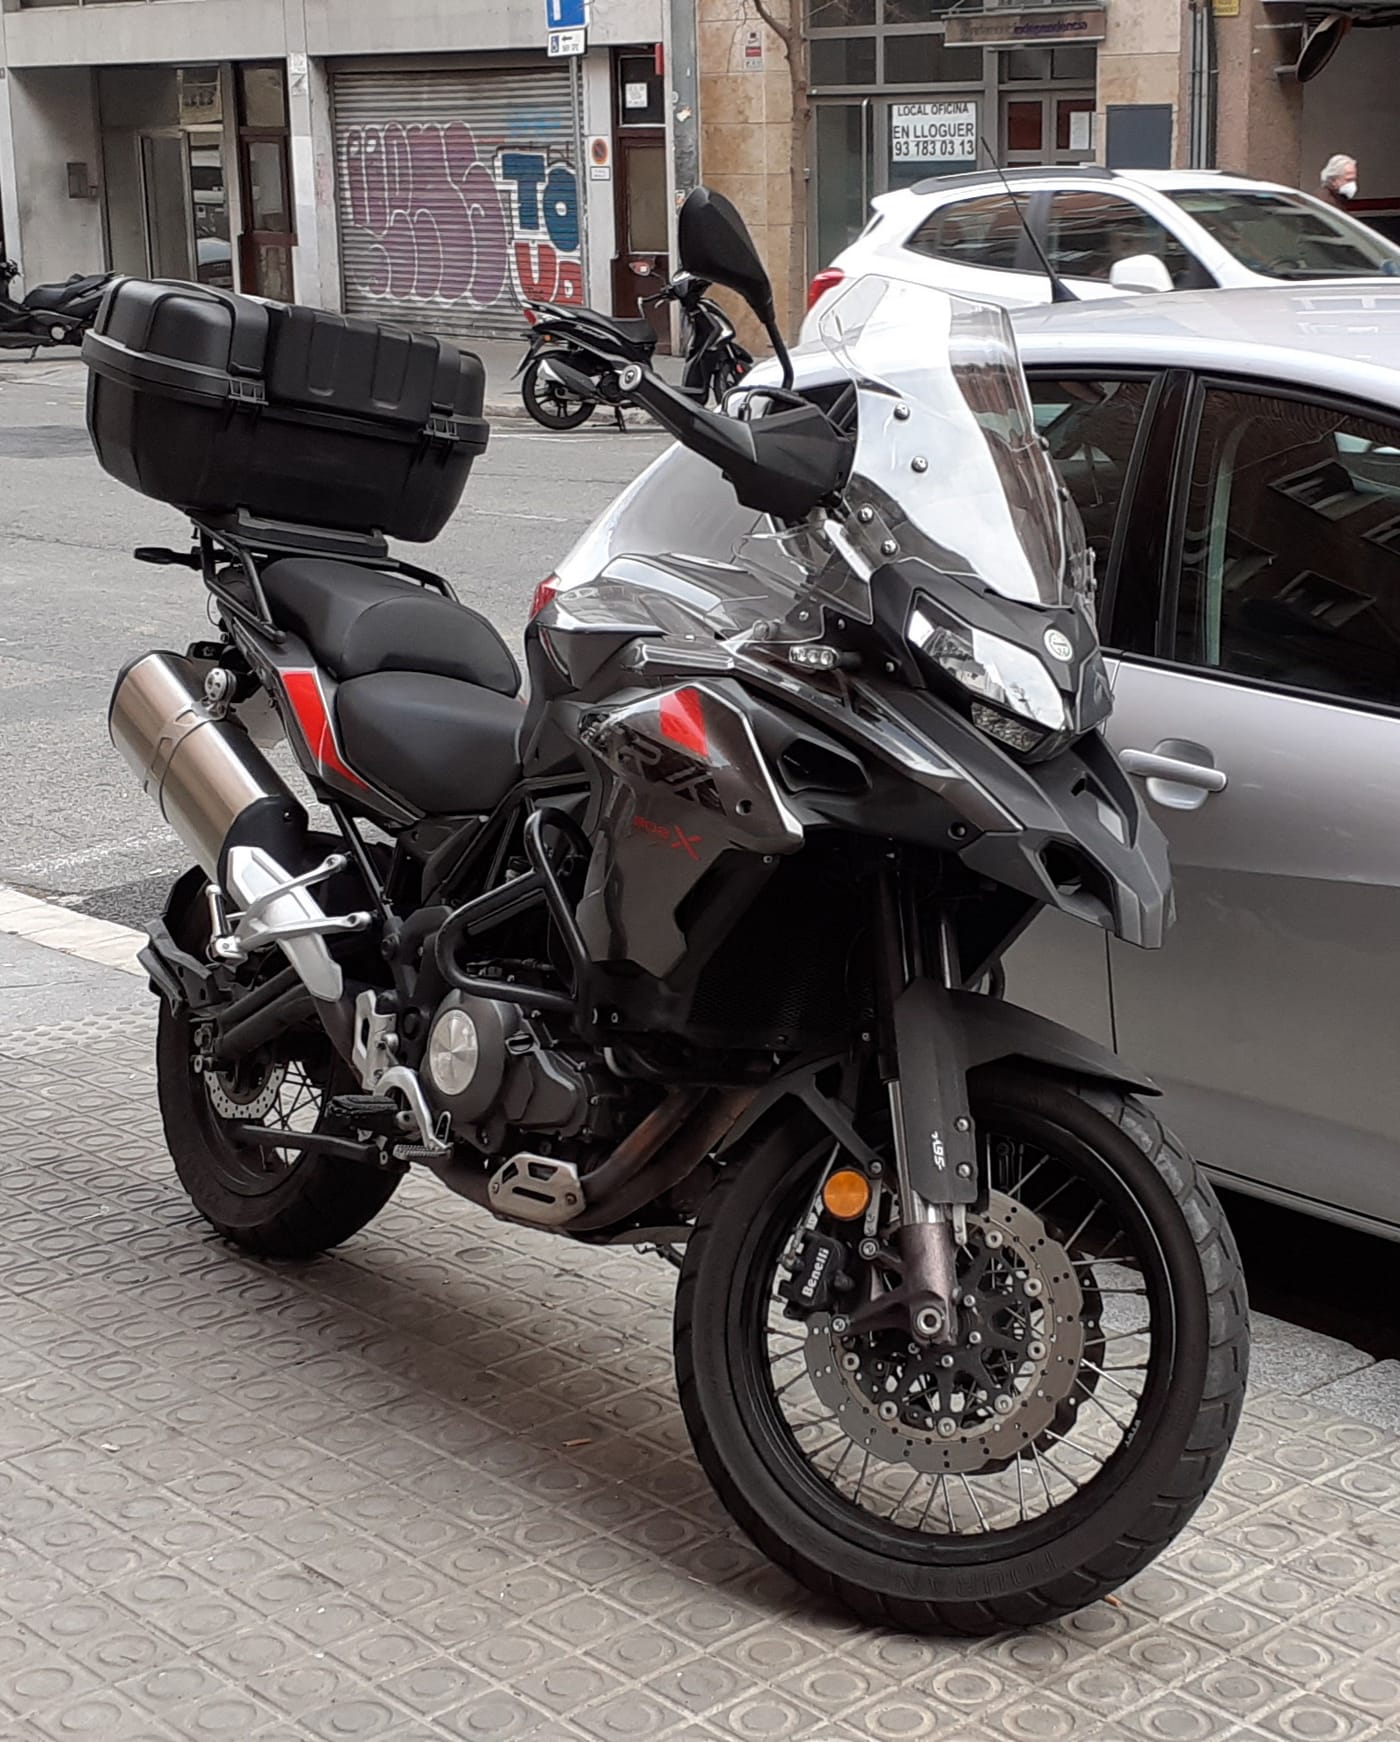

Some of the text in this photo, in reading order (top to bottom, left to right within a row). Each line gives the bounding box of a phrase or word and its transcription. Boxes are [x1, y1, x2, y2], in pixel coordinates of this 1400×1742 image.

[897, 102, 969, 117] LOCAL OFICINA
[893, 122, 974, 139] EN LLOGUER
[894, 139, 974, 157] 93 183 03 13
[802, 1246, 830, 1298] Benelli
